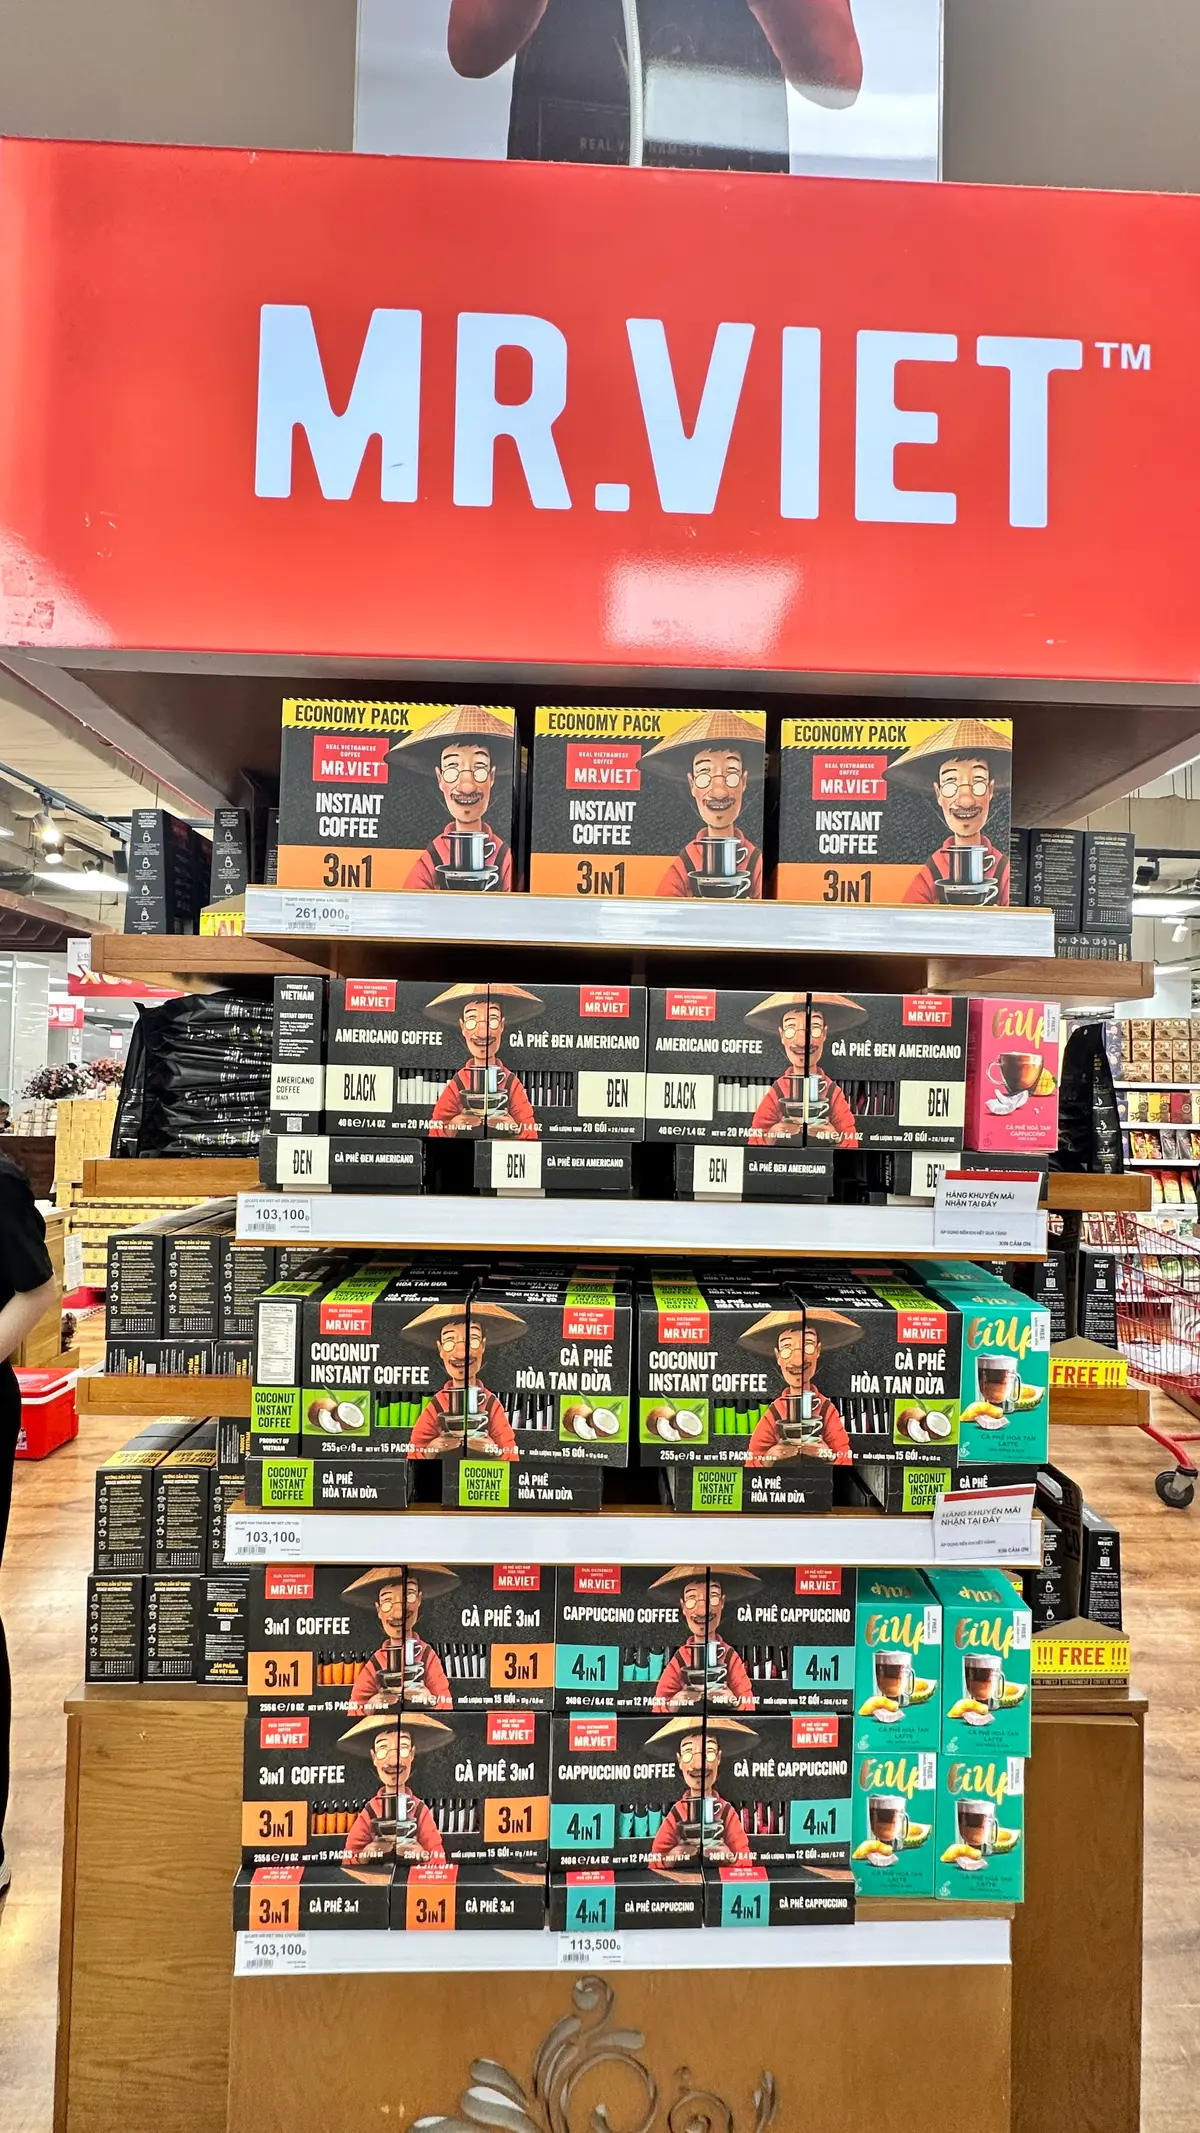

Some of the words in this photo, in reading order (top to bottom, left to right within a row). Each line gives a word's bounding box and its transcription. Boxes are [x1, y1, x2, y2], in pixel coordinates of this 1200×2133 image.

[255, 304, 1083, 528] MR.VIET
[296, 705, 366, 724] ECONOMY
[372, 707, 409, 725] PACK
[549, 713, 618, 731] ECONOMY
[623, 715, 660, 732] PACK
[795, 726, 864, 742] ECONOMY
[869, 726, 906, 742] PACK
[321, 760, 380, 777] MR.VIET
[574, 768, 632, 784] MR.VIET
[820, 779, 879, 794] MR.VIET
[316, 793, 384, 815] INSTANT
[570, 801, 636, 821] INSTANT
[319, 817, 378, 838] COFFEE
[816, 811, 883, 831] INSTANT
[573, 824, 631, 845] COFFEE
[819, 834, 877, 854] COFFEE
[281, 990, 314, 1001] VIETNAM
[351, 996, 390, 1008] MR.VIET
[585, 1002, 625, 1014] MR.VIET
[671, 1005, 710, 1017] MR.VIET
[908, 1011, 946, 1023] MR.VIET
[335, 1029, 398, 1045] AMERICANO
[402, 1030, 442, 1046] COFFEE
[509, 1030, 524, 1048] CÀ
[527, 1031, 549, 1048] PHÊ
[576, 1035, 640, 1050] AMERICANO
[656, 1038, 719, 1053] AMERICANO
[722, 1039, 762, 1054] COFFEE
[832, 1039, 846, 1056] CÀ
[850, 1039, 872, 1057] PHÊ
[898, 1044, 961, 1059] AMERICANO
[344, 1073, 376, 1101] BLACK
[607, 1079, 628, 1108] ĐEN
[664, 1081, 696, 1110] BLACK
[928, 1088, 949, 1117] ĐEN
[419, 1120, 444, 1130] PACKS
[583, 1124, 592, 1132] 20
[293, 1149, 312, 1175] ĐEN
[335, 1152, 344, 1163] CÀ
[346, 1152, 359, 1163] PHÊ
[375, 1154, 414, 1164] AMERICANO
[325, 1319, 365, 1331] MR.VIET
[568, 1323, 609, 1335] MR.VIET
[664, 1328, 704, 1339] MR.VIET
[903, 1328, 941, 1339] MR.VIET
[311, 1343, 379, 1362] COCONUT
[560, 1344, 580, 1367] CÀ
[584, 1345, 612, 1367] PHÊ
[649, 1351, 718, 1370] COCONUT
[895, 1350, 913, 1370] CÀ
[918, 1349, 946, 1371] PHÊ
[311, 1365, 370, 1384] INSTANT
[374, 1366, 429, 1385] COFFEE
[516, 1366, 545, 1389] HÒA
[549, 1372, 580, 1390] TAN
[581, 1369, 612, 1391] DỪA
[649, 1374, 708, 1392] INSTANT
[712, 1374, 767, 1392] COFFEE
[851, 1371, 880, 1393] HÒA
[883, 1376, 912, 1394] TAN
[916, 1374, 944, 1395] DỪA
[1052, 1365, 1098, 1386] FREE
[255, 1392, 295, 1404] COCONUT
[257, 1405, 292, 1416] INSTANT
[258, 1417, 291, 1428] COFFEE
[391, 1443, 415, 1453] PACKS
[267, 1467, 308, 1478] COCONUT
[322, 1470, 333, 1484] CÀ
[336, 1471, 353, 1484] PHÊ
[269, 1479, 305, 1489] INSTANT
[322, 1484, 340, 1499] HÒA
[341, 1488, 359, 1499] TAN
[360, 1486, 378, 1499] DỪA
[271, 1490, 304, 1500] COFFEE
[270, 1584, 309, 1596] MR.VIET
[498, 1576, 536, 1587] MR.VIET
[579, 1579, 616, 1590] MR.VIET
[800, 1580, 837, 1591] MR.VIET
[461, 1604, 479, 1627] CÀ
[484, 1605, 513, 1627] PHÊ
[563, 1606, 634, 1623] CAPPUCCINO
[637, 1608, 679, 1623] COFFEE
[737, 1604, 752, 1622] CÀ
[755, 1604, 778, 1622] PHÊ
[781, 1607, 850, 1623] CAPPUCCINO
[296, 1616, 350, 1635] COFFEE
[1059, 1647, 1105, 1665] FREE
[291, 1765, 345, 1784] COFFEE
[455, 1759, 473, 1782] CÀ
[478, 1759, 506, 1781] PHÊ
[558, 1764, 630, 1780] CAPPUCCINO
[633, 1763, 675, 1779] COFFEE
[734, 1759, 749, 1778] CÀ
[752, 1758, 774, 1777] PHÊ
[777, 1761, 847, 1777] CAPPUCCINO
[625, 1900, 635, 1913] CÀ
[635, 1899, 650, 1913] PHÊ
[651, 1901, 694, 1913] CAPPUCCINO
